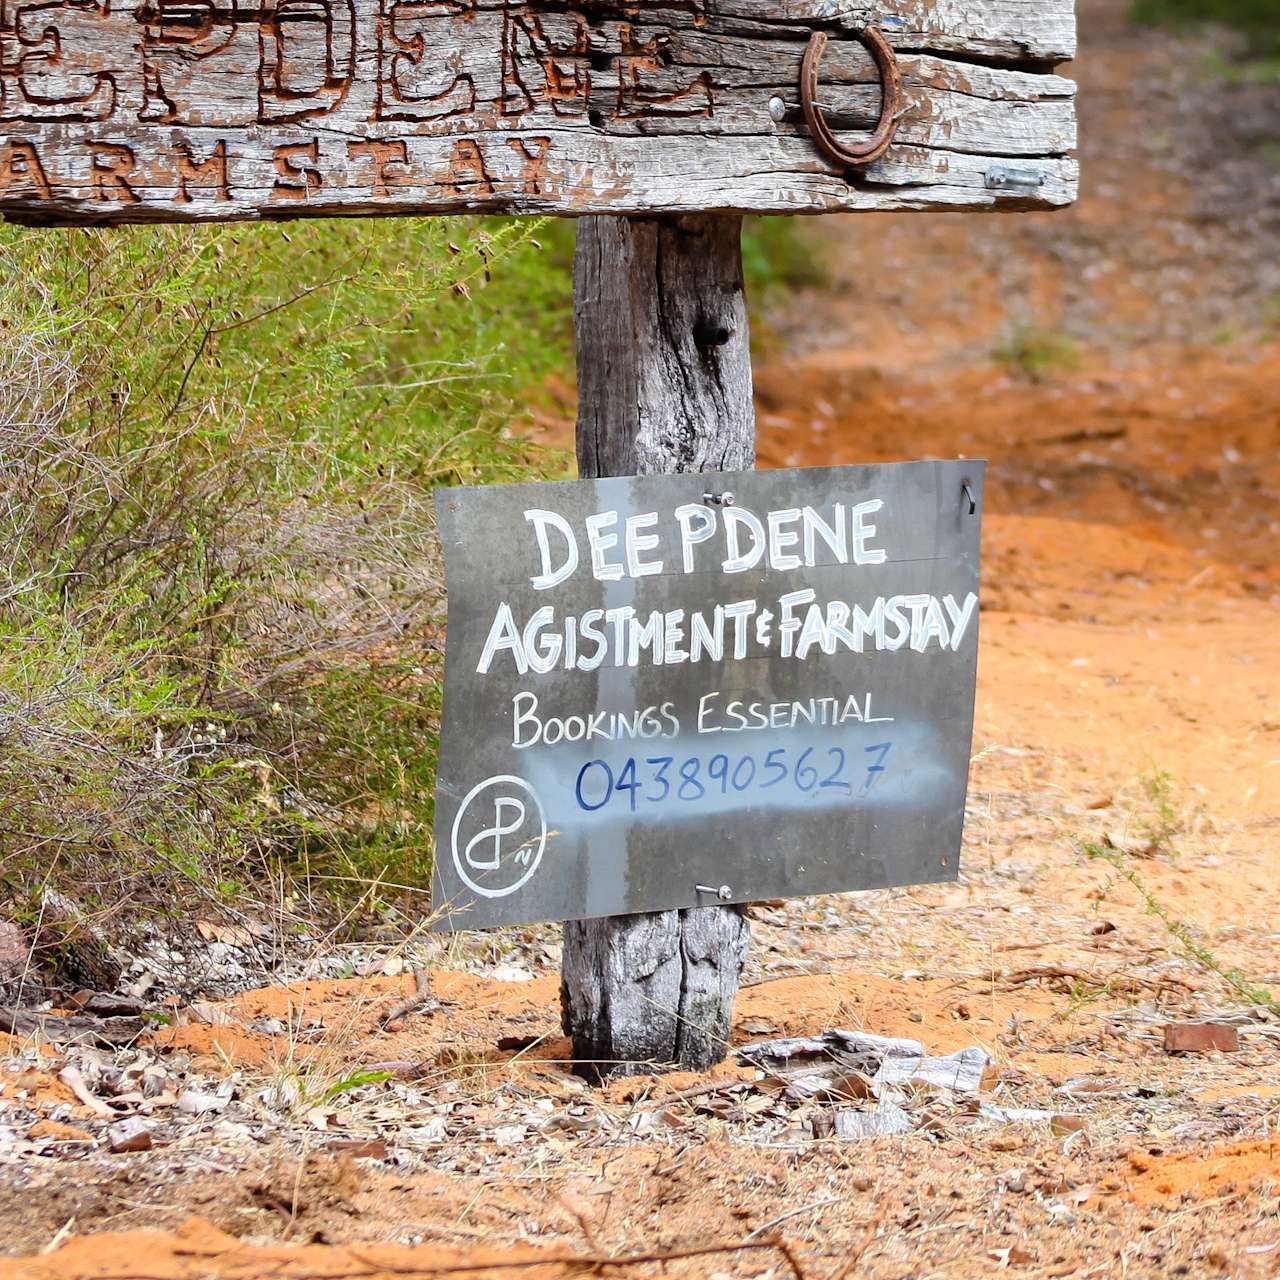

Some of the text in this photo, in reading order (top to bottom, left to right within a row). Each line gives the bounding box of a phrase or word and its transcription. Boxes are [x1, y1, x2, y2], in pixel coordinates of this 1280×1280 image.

[476, 599, 756, 675] AGISTMENT
[778, 588, 978, 660] FARMSTAY
[510, 690, 895, 749] BOOKINGS ESSENTIAL
[575, 741, 892, 812] 0438905627
